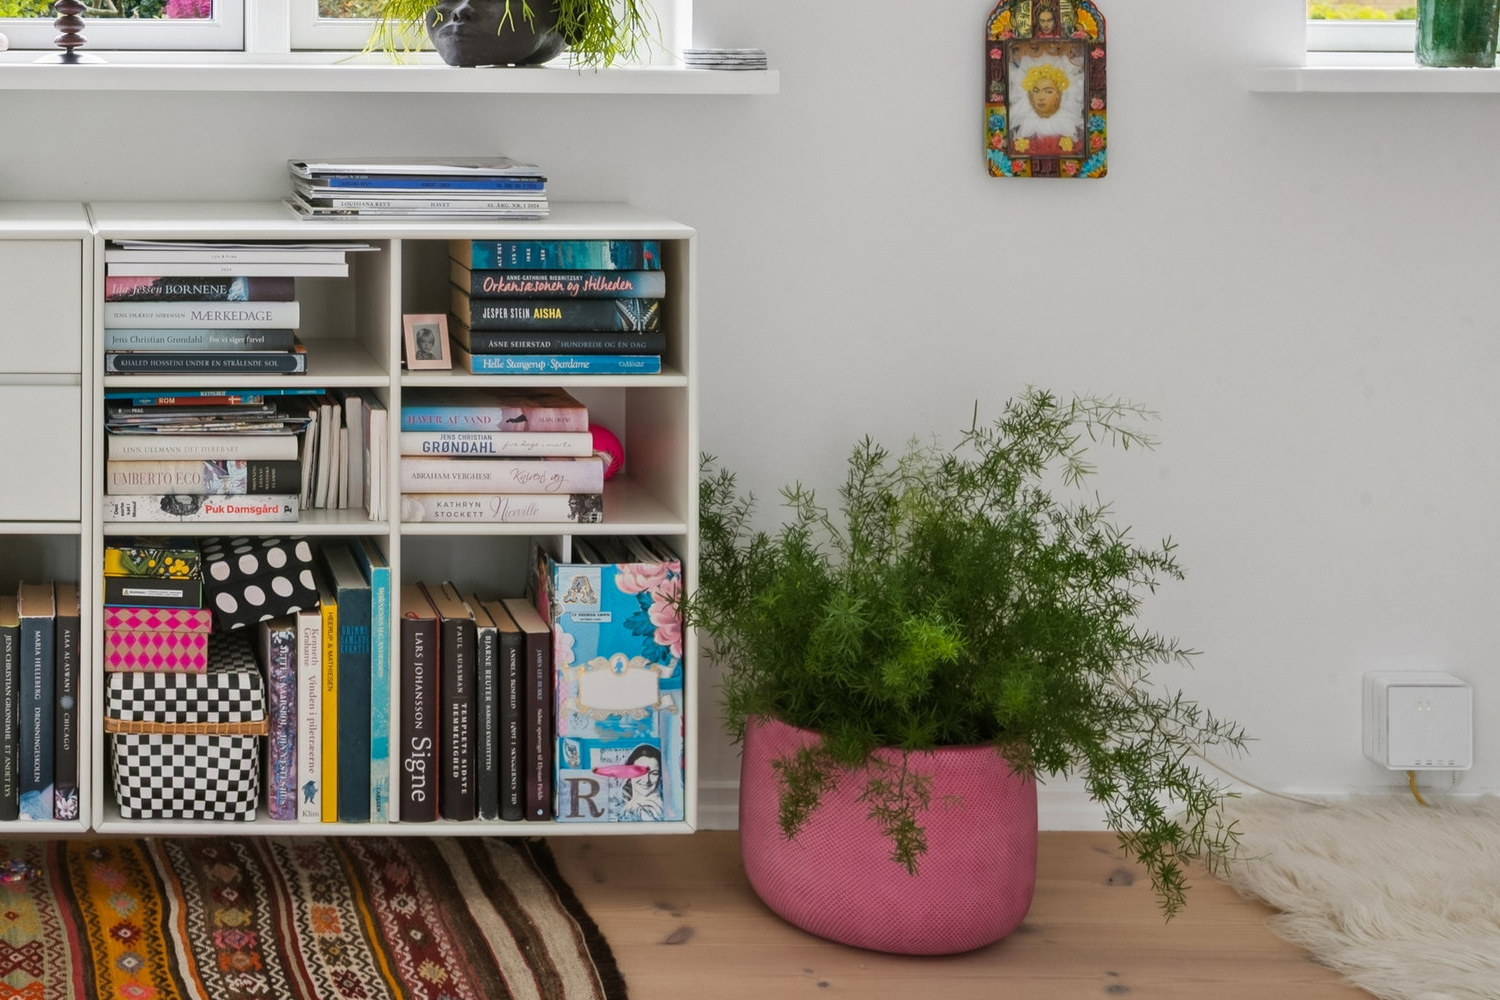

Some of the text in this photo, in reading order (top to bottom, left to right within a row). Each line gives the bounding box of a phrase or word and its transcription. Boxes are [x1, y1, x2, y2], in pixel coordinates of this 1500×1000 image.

[112, 283, 228, 297] Ida Jessen BØRNENE
[483, 276, 634, 297] Orkansæsonen og stilheden
[190, 310, 273, 322] MÆRKEDAGE
[482, 308, 562, 319] JESPER STEIN AISHA
[112, 334, 265, 346] Jens Christian Grøndahl siger farvel
[488, 339, 510, 348] ÅSNE
[511, 340, 551, 348] SEIERSTAD
[604, 340, 616, 348] OG
[629, 340, 647, 348] DAG
[120, 357, 278, 367] KHALED HOSSEINI UNDER EN STRÅLENDE SOL
[482, 358, 590, 372] Helle Stangerup Spardame
[158, 397, 176, 405] ROM
[406, 414, 492, 425] HAVER AF VAND
[440, 433, 493, 441] JENS CHRISTIAN
[422, 441, 496, 454] GRØNDAHL
[112, 472, 201, 486] UMBERTO ECO
[411, 472, 451, 480] ABRAHAM
[452, 472, 492, 480] VERGHESE
[205, 503, 279, 516] Puk Damsgård
[489, 495, 540, 522] Niceville
[3, 634, 13, 652] JENS
[63, 629, 71, 648] ALAA
[456, 626, 464, 649] PAUL
[303, 627, 312, 667] Grahame
[311, 628, 320, 666] Kenneth
[484, 635, 492, 666] BJARNE
[4, 653, 12, 696] CHRISTIAN
[63, 651, 71, 693] AL-ASWANY
[413, 632, 423, 729] LARS JOHANSSON
[484, 669, 492, 702] REUTER
[33, 630, 42, 783] MARIA HELLEBERG DRONNINGESKOLEN
[306, 675, 317, 774] Vinden piletræerne
[4, 745, 11, 755] ET
[452, 703, 460, 779] HEMMELIGHED
[404, 737, 432, 802] Signe
[564, 778, 605, 819] R
